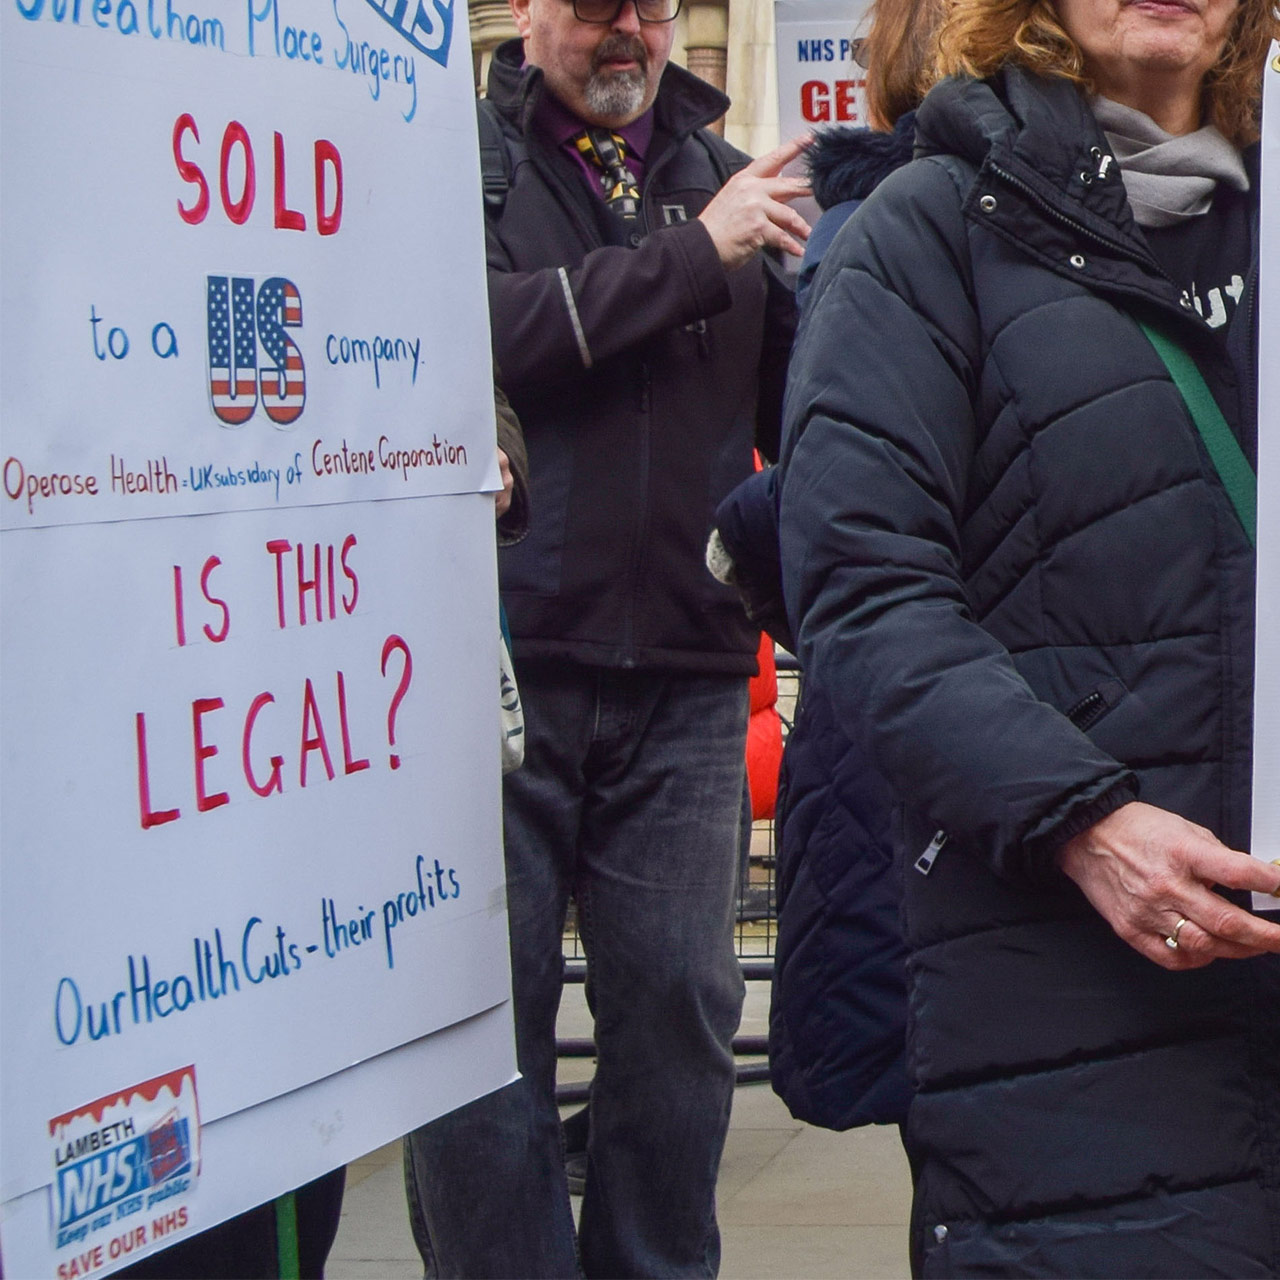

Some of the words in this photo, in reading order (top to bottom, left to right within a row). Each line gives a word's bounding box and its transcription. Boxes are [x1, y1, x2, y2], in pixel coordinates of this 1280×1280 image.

[797, 38, 835, 62] NHS
[172, 112, 344, 236] SOLD
[89, 303, 130, 361] to
[151, 321, 179, 359] a
[207, 275, 307, 425] US
[3, 456, 99, 515] Operose
[110, 453, 178, 495] Health
[286, 452, 302, 485] of
[311, 439, 376, 477] Centene
[378, 433, 468, 482] Corporation
[173, 554, 231, 648] IS
[265, 533, 360, 630] THIS
[135, 634, 413, 830] LEGAL?
[55, 977, 127, 1046] Our
[127, 927, 241, 1025] Health
[241, 916, 302, 984] Cuts
[321, 896, 376, 959] their
[383, 854, 461, 970] profits
[55, 1116, 136, 1167] LAMBETH
[62, 1140, 139, 1224] NHS
[56, 1245, 104, 1280] SAVE
[108, 1225, 148, 1260] OUR
[152, 1206, 190, 1240] NHS
